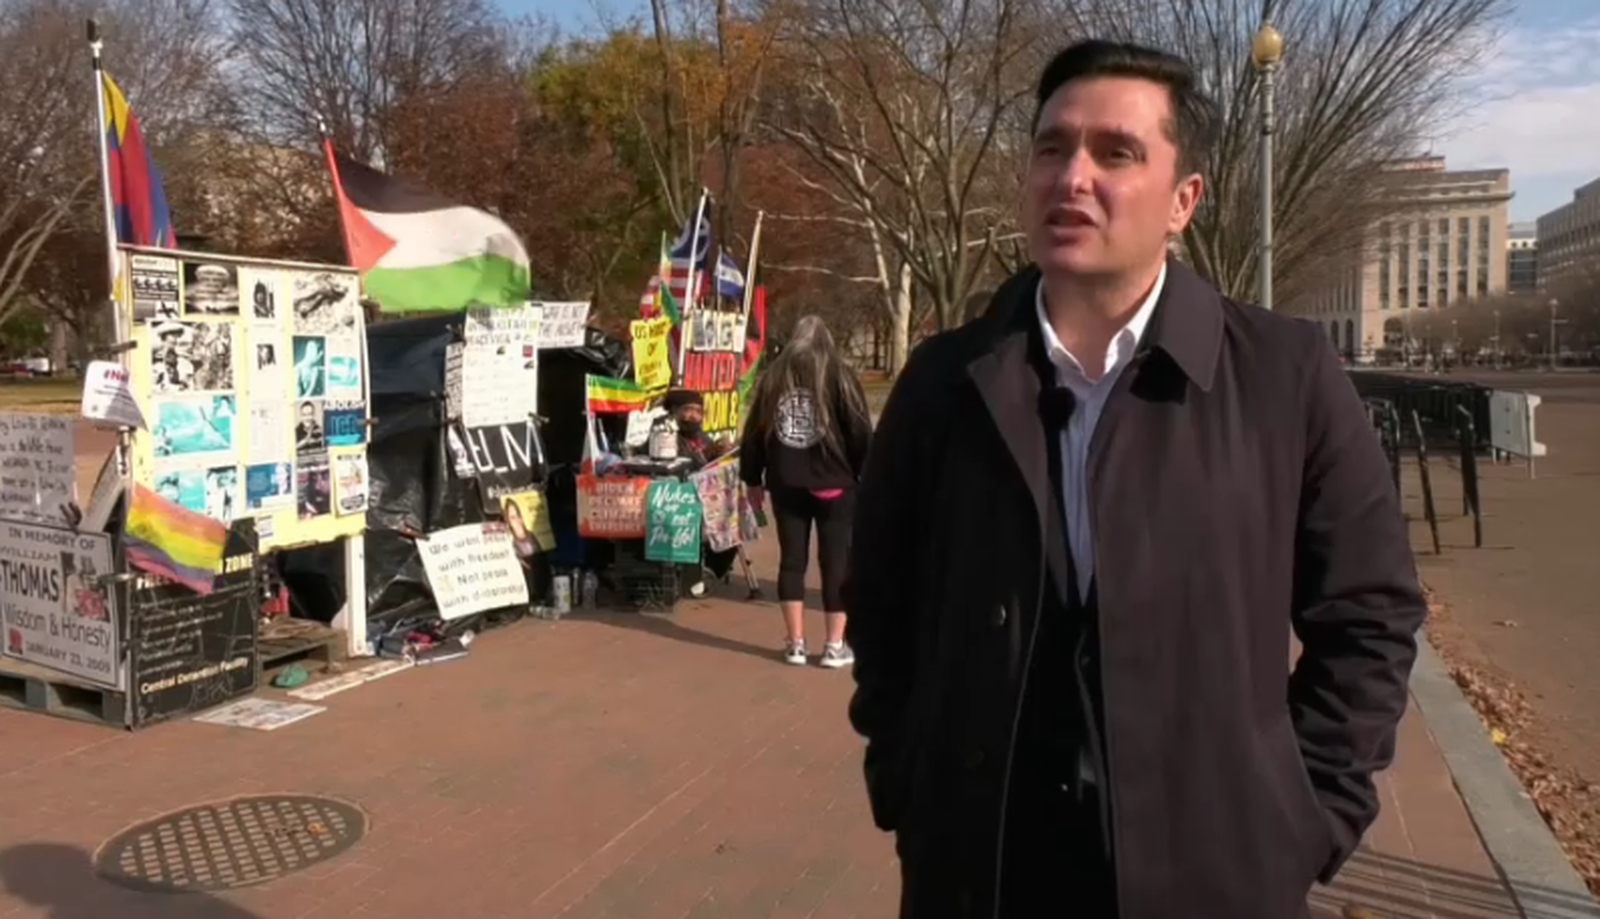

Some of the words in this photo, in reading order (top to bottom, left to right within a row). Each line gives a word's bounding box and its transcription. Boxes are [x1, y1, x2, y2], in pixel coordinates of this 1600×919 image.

[652, 483, 696, 508] Nukes
[672, 508, 694, 526] not
[8, 526, 22, 539] IN
[25, 529, 75, 548] MEMORY
[80, 538, 96, 551] OF
[0, 545, 58, 562] WILLIAM
[225, 553, 254, 575] ZONE
[1, 559, 59, 602] THOMAS
[4, 603, 46, 632] Wisdom
[50, 608, 60, 637] &
[62, 612, 111, 653] Honesty
[25, 640, 67, 664] JANUARY
[86, 656, 111, 675] 2009
[141, 675, 176, 694] Central
[177, 665, 219, 684] Detention
